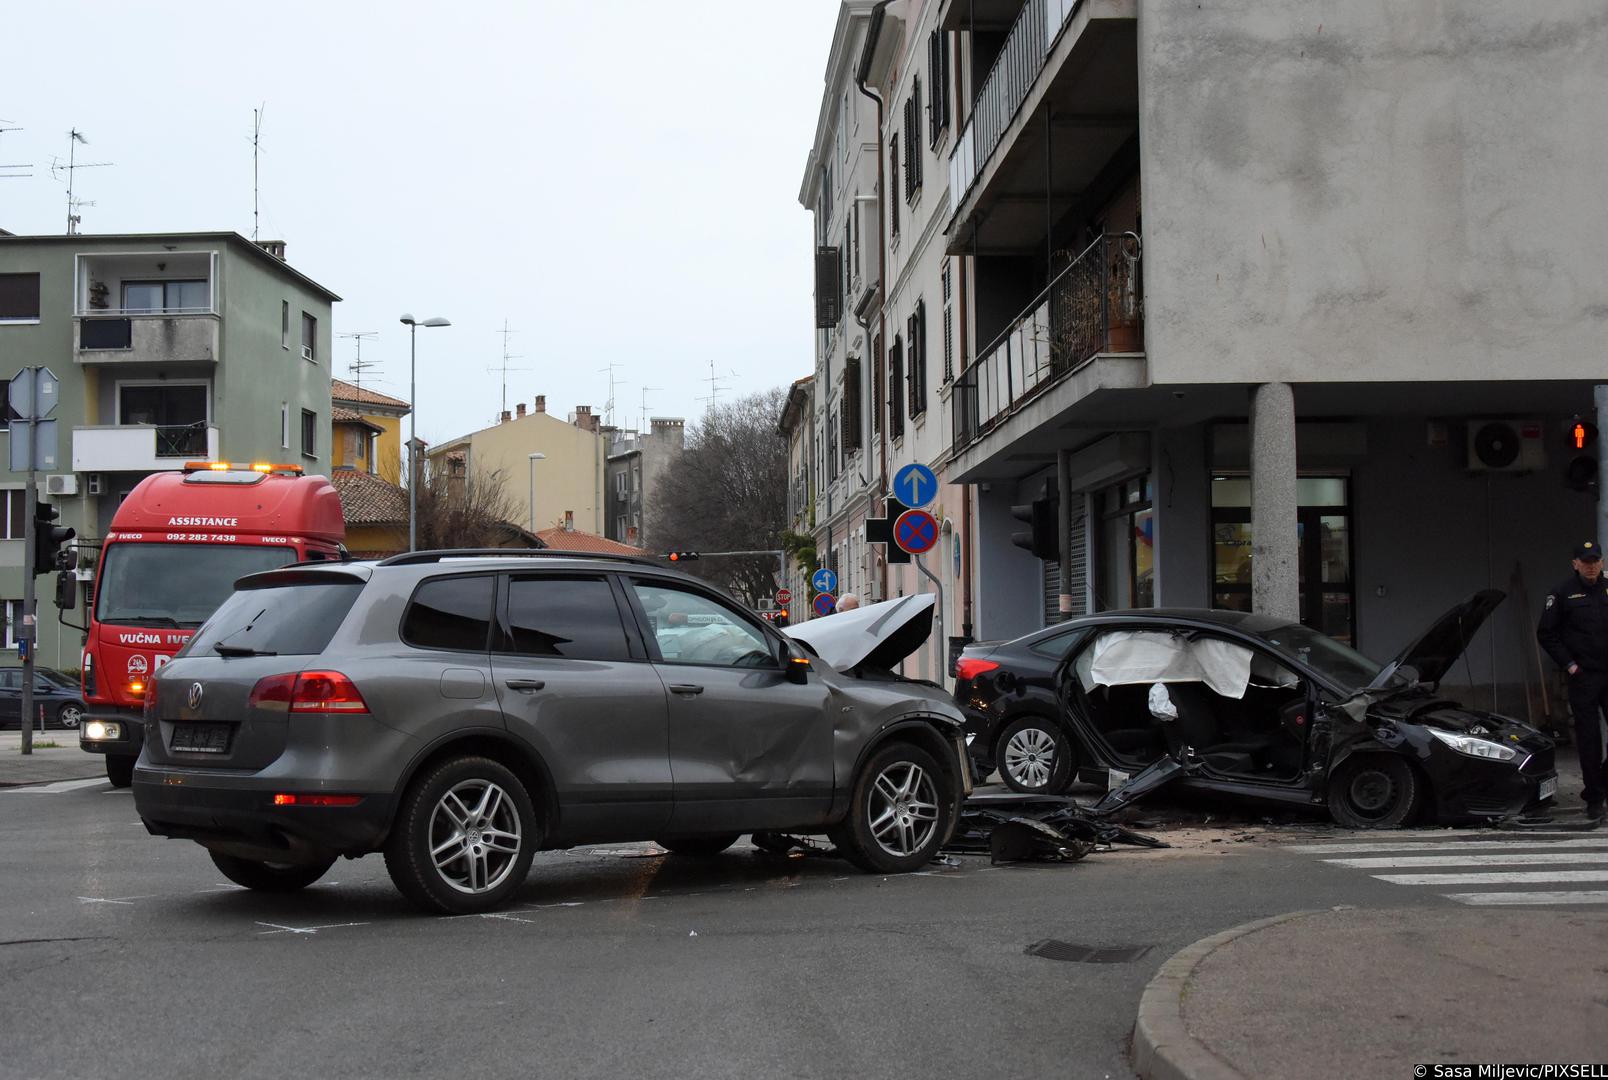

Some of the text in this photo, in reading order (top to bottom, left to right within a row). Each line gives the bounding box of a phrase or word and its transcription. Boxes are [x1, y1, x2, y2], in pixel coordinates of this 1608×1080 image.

[168, 517, 238, 526] ASSISTANCE
[166, 533, 186, 541] 092
[211, 534, 236, 542] 7438
[120, 632, 190, 644] VUČNA IVE
